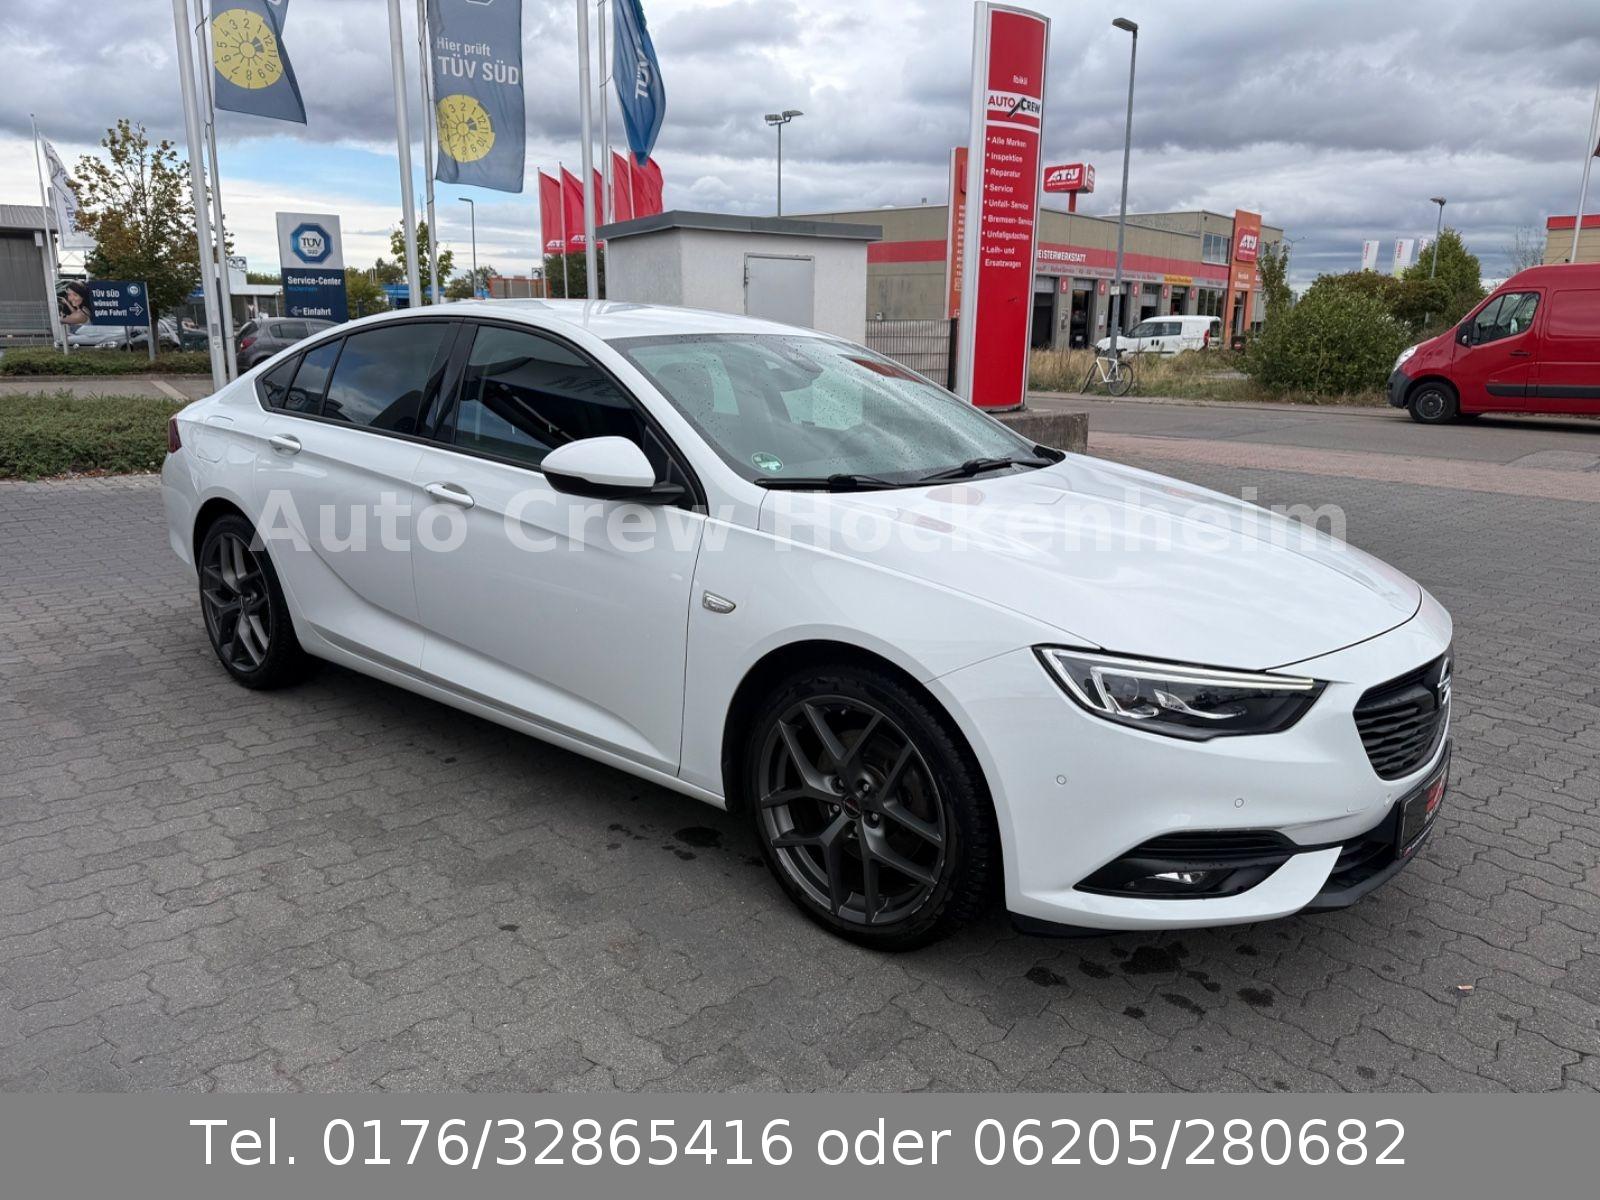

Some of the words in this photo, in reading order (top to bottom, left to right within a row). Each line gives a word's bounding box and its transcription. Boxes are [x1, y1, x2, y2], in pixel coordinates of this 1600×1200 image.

[229, 19, 238, 30] 3
[243, 18, 250, 29] 2
[263, 34, 273, 47] 12
[436, 36, 461, 52] Hier
[464, 43, 491, 57] prüft
[265, 61, 276, 72] 10
[437, 53, 477, 78] TÜV
[482, 60, 519, 85] SÜD
[246, 69, 252, 80] 8
[460, 102, 466, 111] 2
[987, 95, 1016, 108] AUTO
[448, 104, 456, 113] 3
[992, 136, 1005, 145] Alle
[1006, 138, 1027, 148] Marken
[991, 152, 1023, 163] Inspektion
[990, 167, 1021, 178] Reparatur
[989, 183, 1014, 193] Service
[988, 199, 1010, 208] Unfall-
[987, 214, 1016, 224] Bremsen-
[986, 230, 1030, 241] Unfallgutachten
[986, 246, 1003, 254] Leih-
[1003, 247, 1015, 255] und
[1037, 249, 1087, 262] EISTERWERKSTATT
[984, 258, 1022, 269] Ersatzwagen
[287, 275, 342, 286] Service-Center
[92, 289, 105, 297] TÜV
[106, 289, 120, 298] SÜD
[302, 307, 332, 316] Einfahrt
